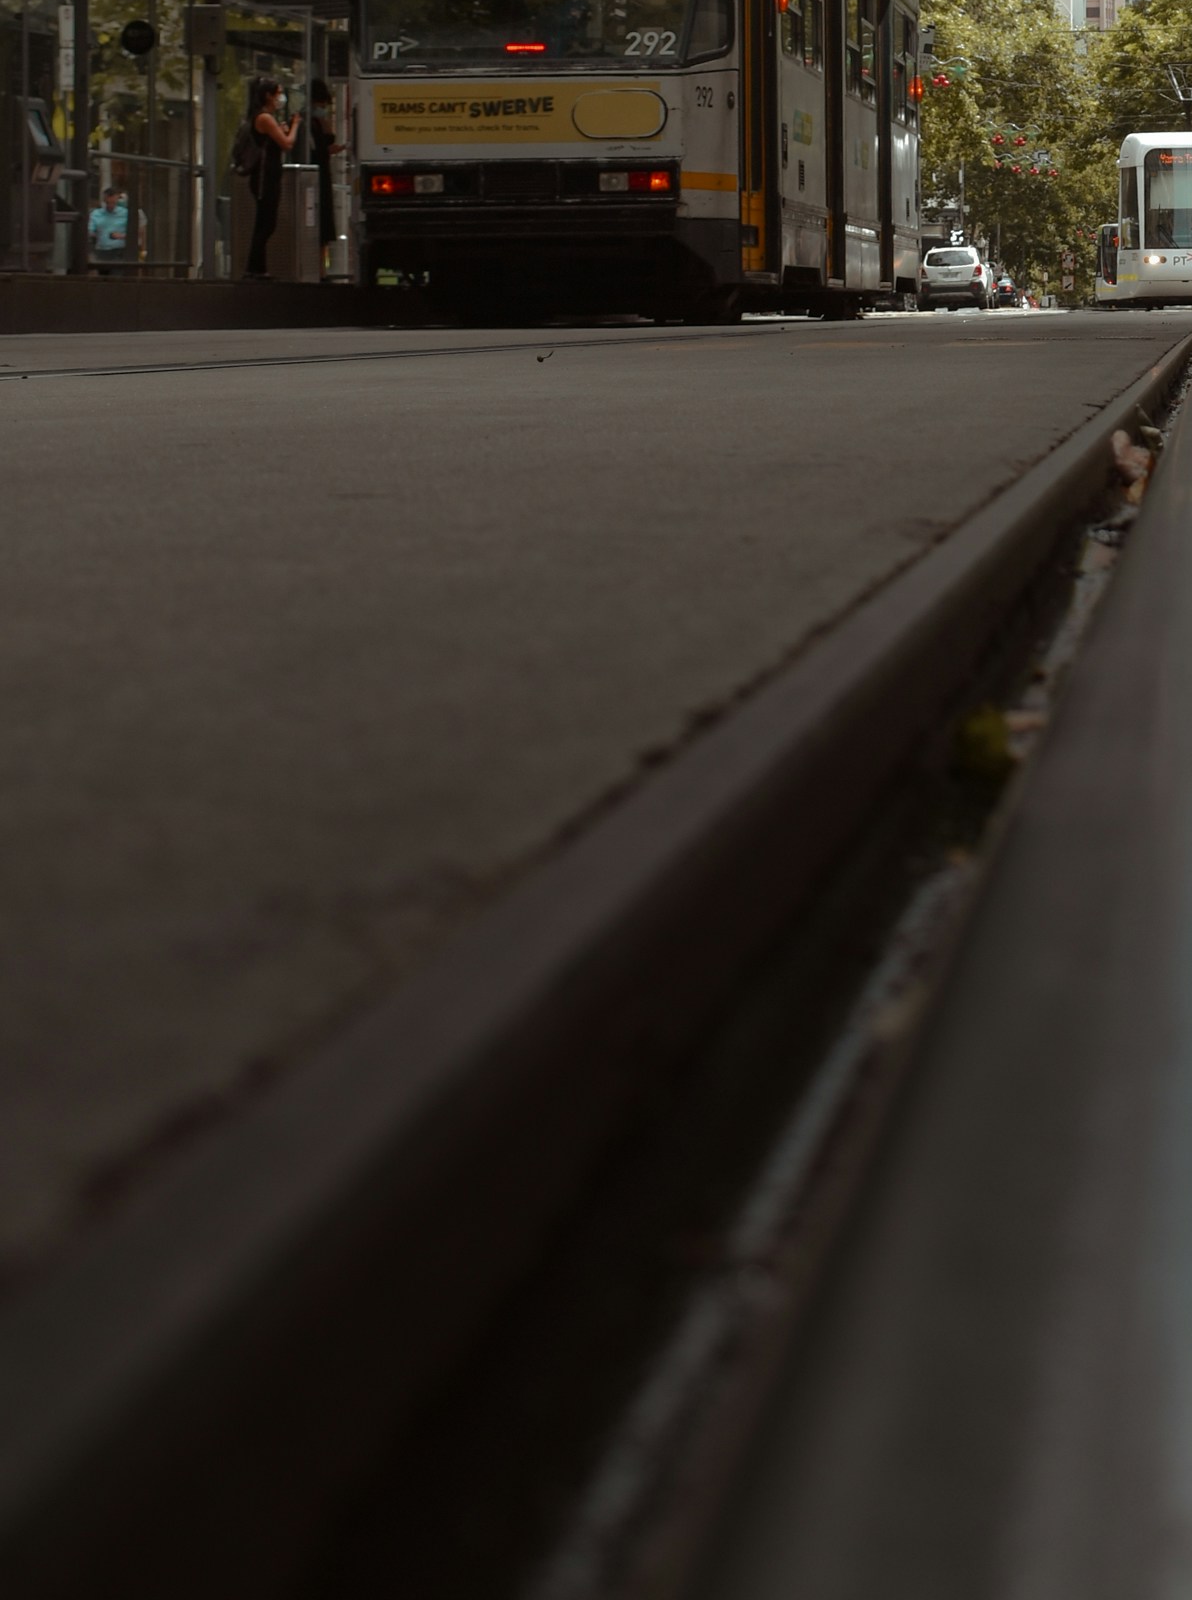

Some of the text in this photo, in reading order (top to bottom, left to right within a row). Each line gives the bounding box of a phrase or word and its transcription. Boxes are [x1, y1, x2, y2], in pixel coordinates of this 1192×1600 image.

[624, 32, 677, 56] 292
[381, 96, 554, 118] TRAMS CAN'T SWERVE
[696, 86, 714, 108] 292
